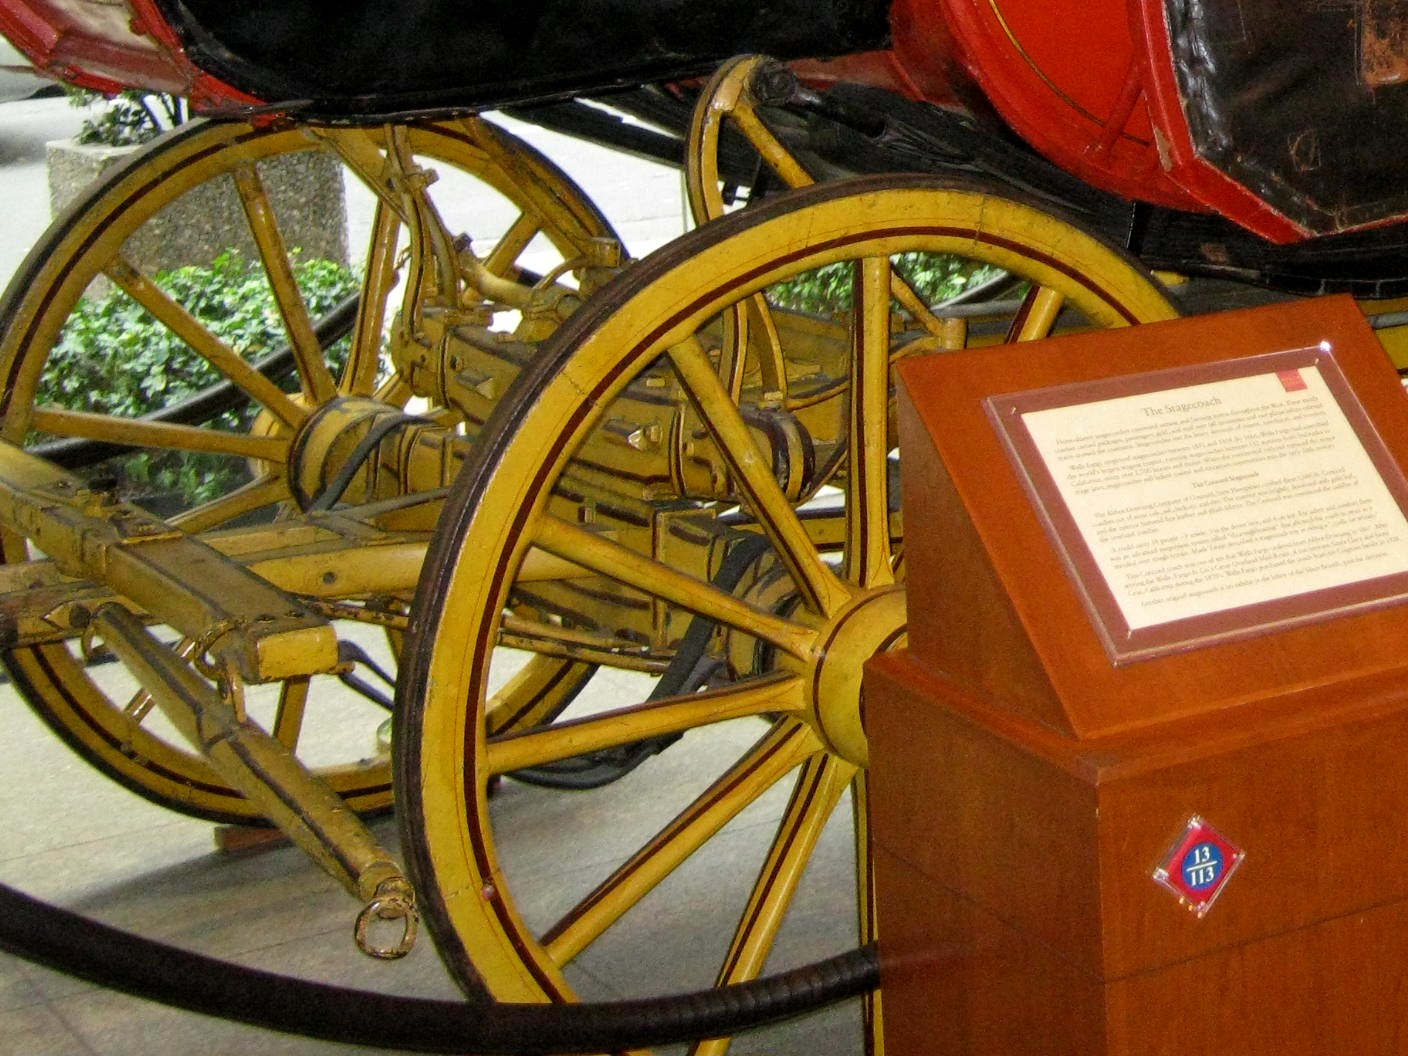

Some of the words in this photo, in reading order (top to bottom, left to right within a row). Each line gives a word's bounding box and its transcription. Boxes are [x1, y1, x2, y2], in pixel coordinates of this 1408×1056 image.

[1143, 406, 1164, 417] The
[1164, 396, 1223, 414] Stagecoach
[1194, 846, 1210, 864] 13
[1191, 865, 1215, 887] 113
